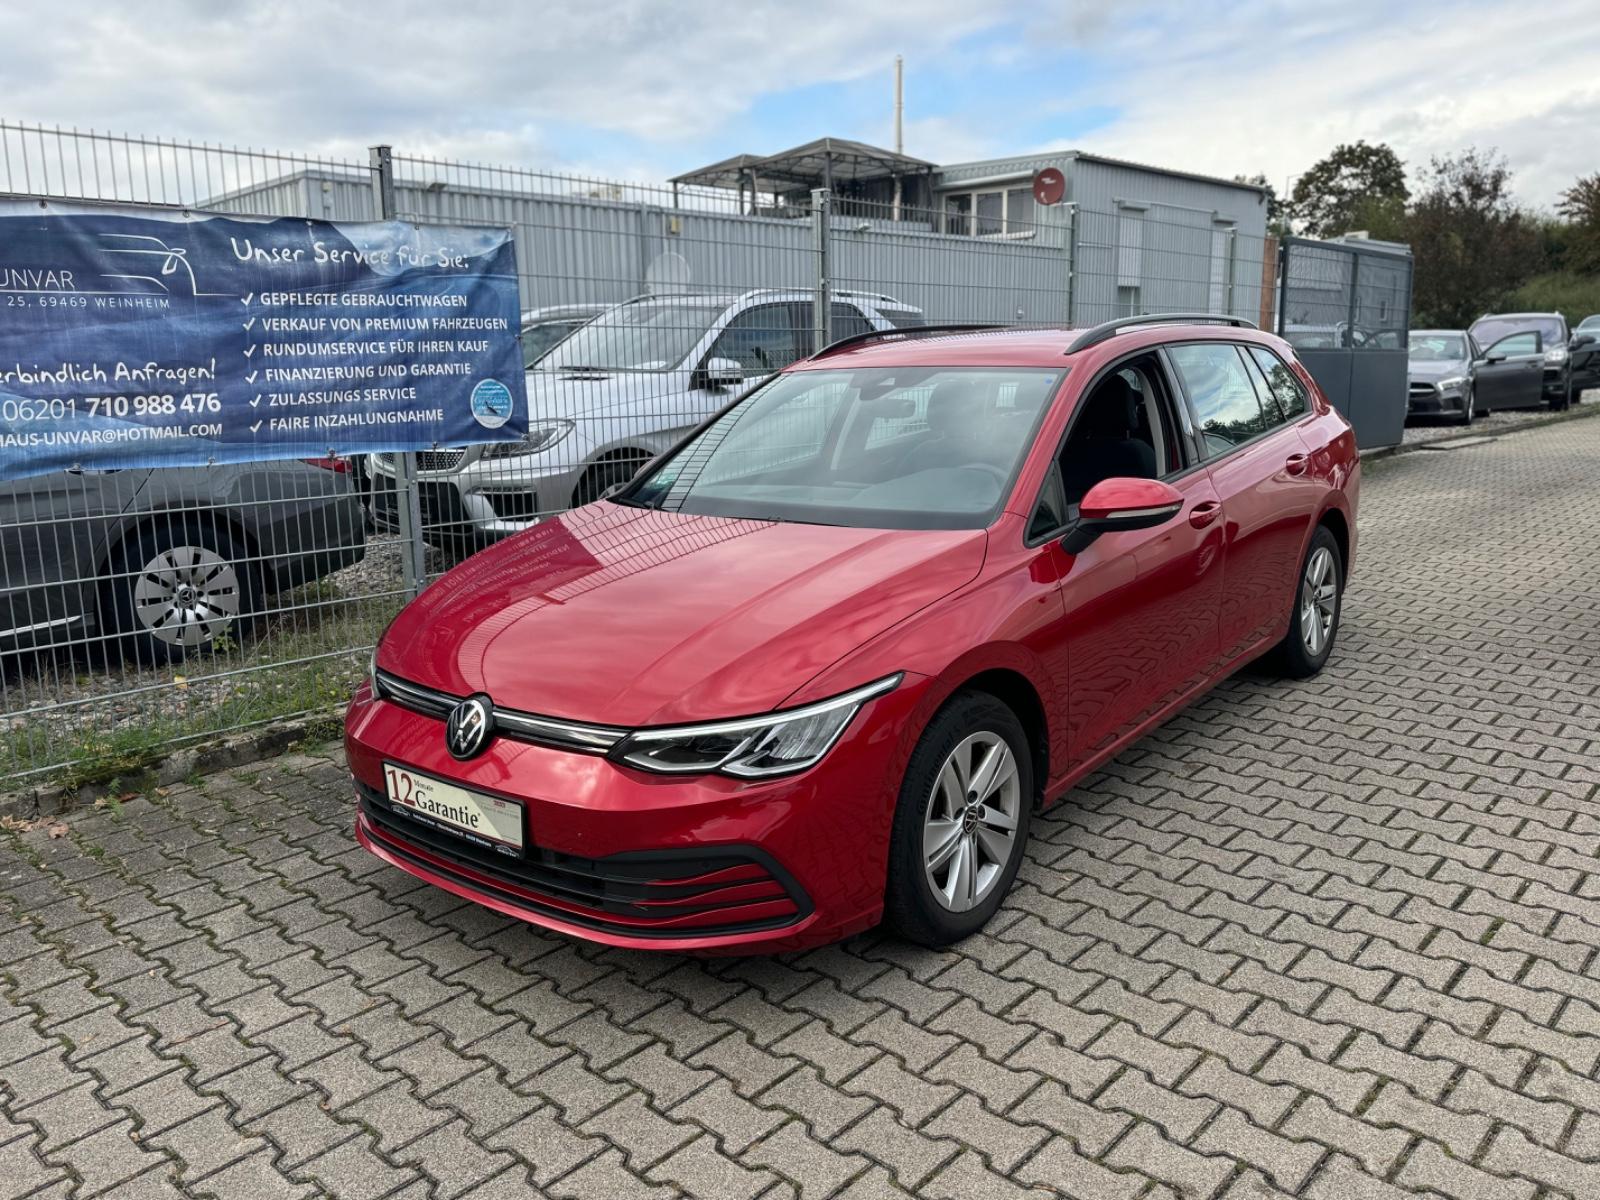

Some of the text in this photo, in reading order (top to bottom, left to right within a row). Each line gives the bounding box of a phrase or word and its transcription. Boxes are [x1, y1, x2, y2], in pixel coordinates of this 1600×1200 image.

[230, 237, 469, 269] Unser Service für Sie:
[8, 295, 170, 309] 25, 69469 WEINHEIM
[260, 292, 467, 307] GEPFLEGTE GEBRAUCHTWAGEN
[262, 317, 508, 331] VERKAUF VON PREMIUM FAHRZEUGEN
[264, 339, 489, 357] RUNDUMSERVICE FÜR IHREN KAUF
[115, 357, 215, 385] Anfragen!
[266, 362, 471, 382] FINANZIERUNG UND GARANTIE
[3, 392, 221, 421] 06201 710 988 476
[269, 387, 416, 407] ZULASSUNGS SERVICE
[270, 409, 444, 431] FAIRE INZAHLUNGNAHME
[387, 769, 416, 807] 12
[415, 790, 479, 829] Garantie
